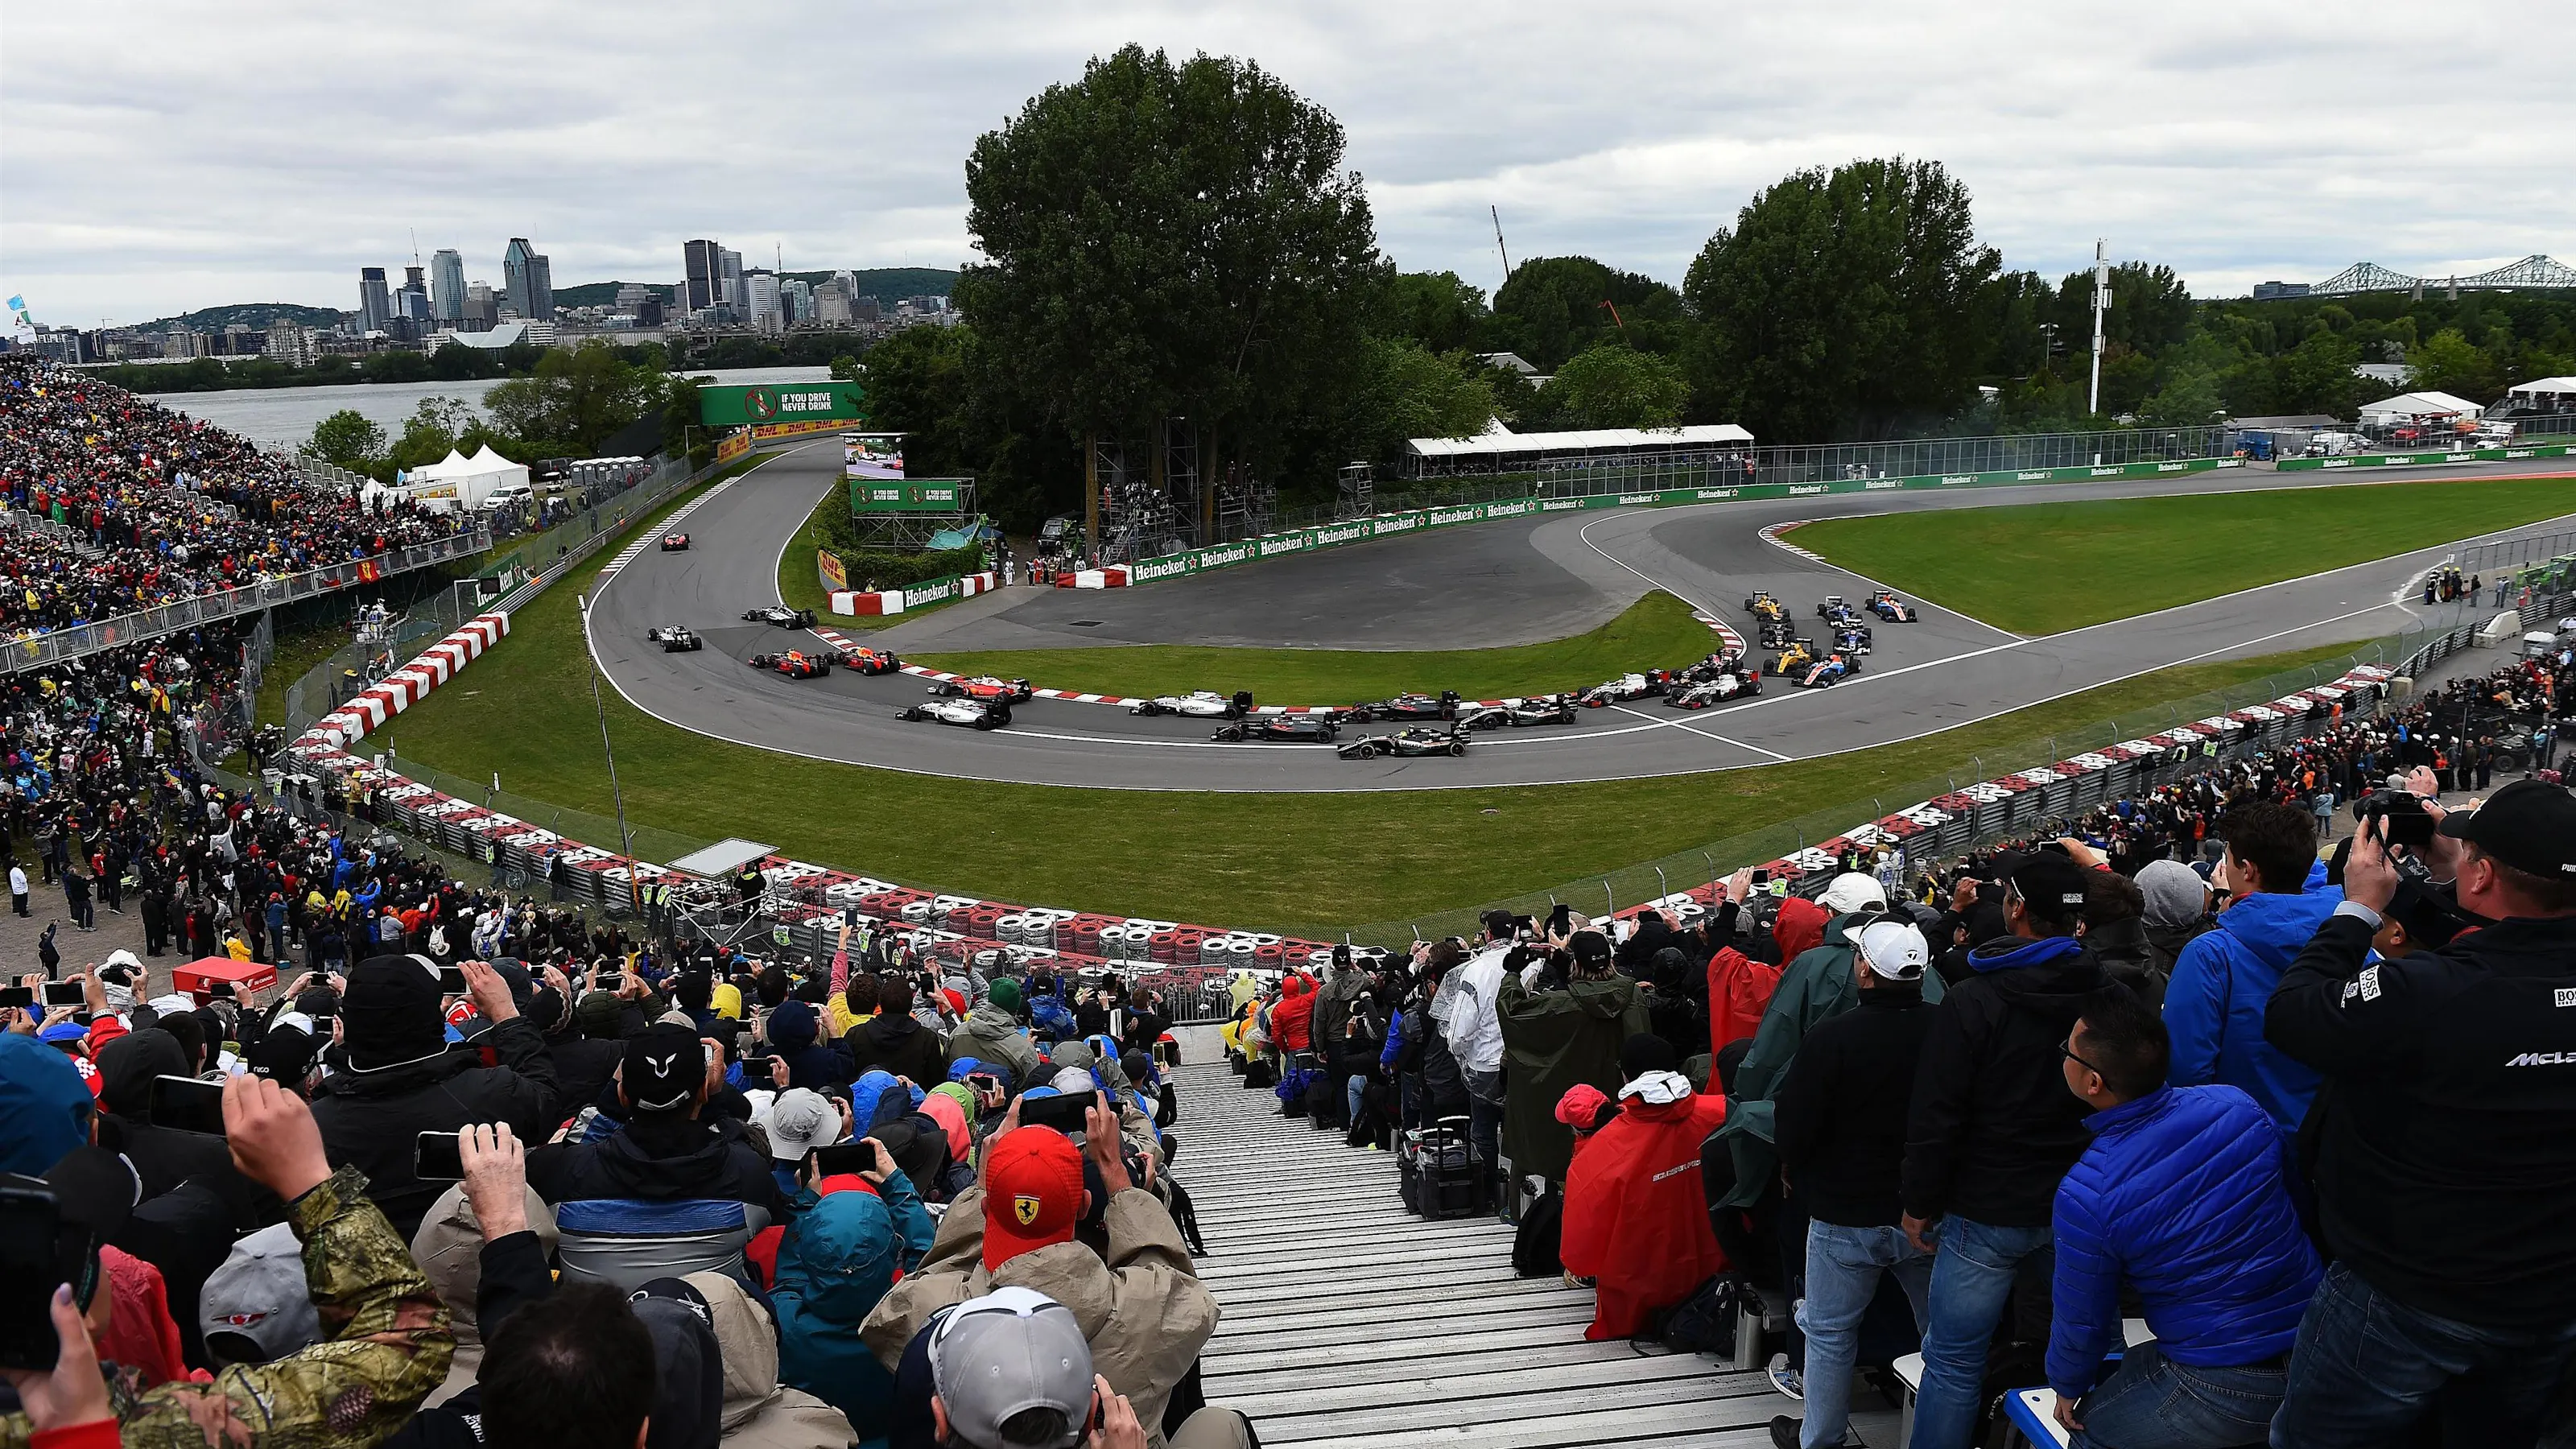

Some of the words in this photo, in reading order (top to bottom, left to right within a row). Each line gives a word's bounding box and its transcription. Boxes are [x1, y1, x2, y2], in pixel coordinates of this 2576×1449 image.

[782, 394, 789, 402] IF
[791, 394, 807, 402] YOU
[808, 392, 832, 402] DRIVE
[782, 402, 807, 411] NEVER
[808, 402, 832, 411] DRINK
[757, 427, 778, 437] DHL
[787, 423, 806, 433] DHL
[815, 421, 833, 430] DHL
[1698, 489, 1731, 498] Heineken
[1789, 485, 1821, 494] Heineken
[1543, 500, 1576, 510] Heineken
[1619, 495, 1653, 505] Heineken
[1488, 502, 1525, 517] Heineken
[1430, 508, 1474, 525] Heineken
[1374, 517, 1415, 535] Heineken
[1317, 526, 1360, 546] Heineken
[1261, 537, 1303, 555] Heineken
[1201, 549, 1245, 568] Heineken
[822, 553, 840, 580] DHL
[1135, 559, 1185, 580] Heineken
[905, 582, 950, 608] Heineken
[2365, 967, 2378, 997] OSS
[2557, 990, 2576, 1001] BO
